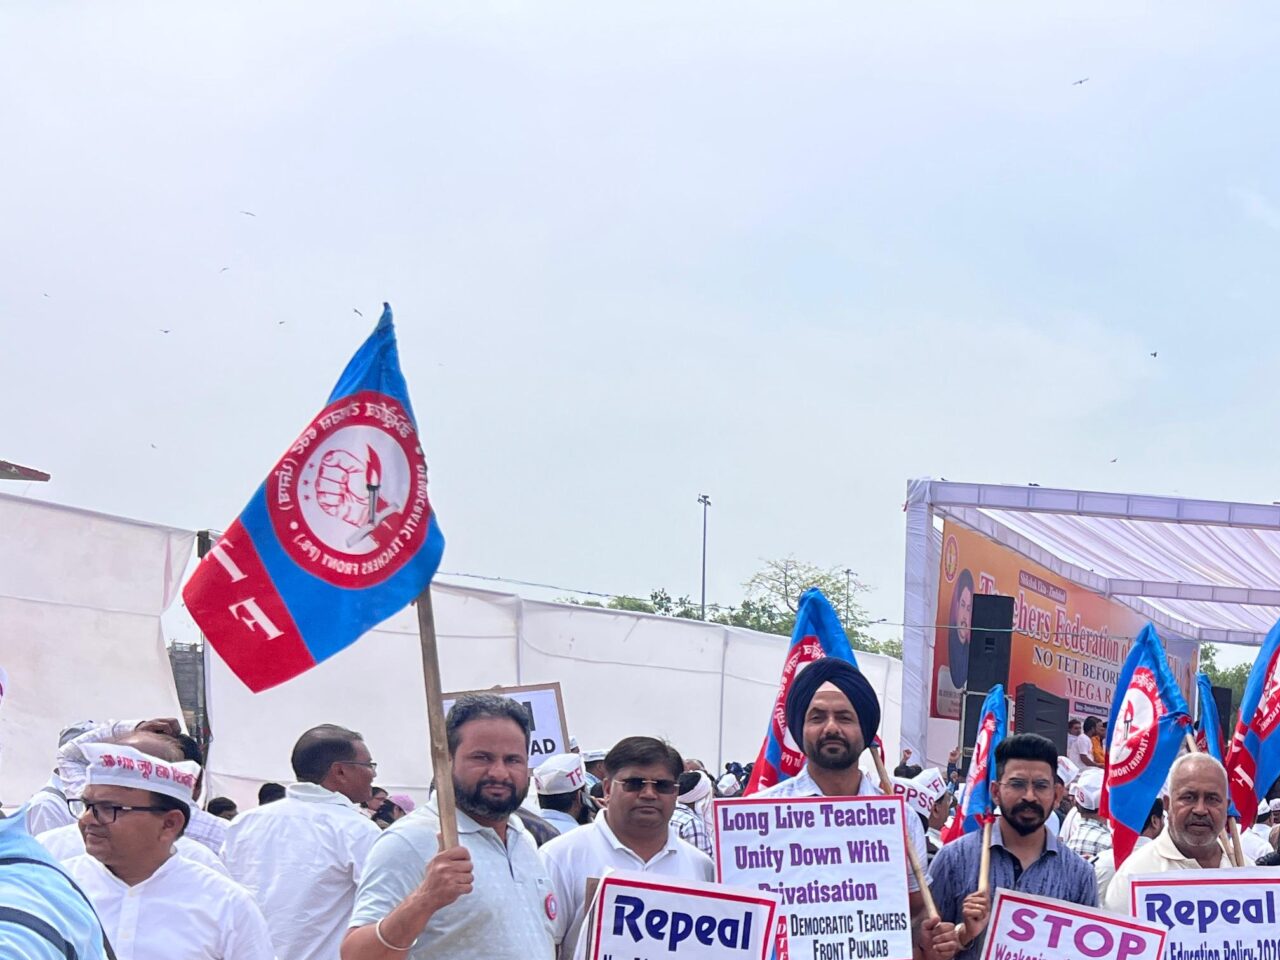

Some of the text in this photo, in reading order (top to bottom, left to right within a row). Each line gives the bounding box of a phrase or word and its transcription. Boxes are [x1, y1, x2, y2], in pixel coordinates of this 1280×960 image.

[980, 574, 1051, 641] Tchers
[1054, 608, 1119, 663] Federation
[1034, 646, 1053, 667] NO
[1056, 654, 1079, 675] TET
[722, 803, 896, 836] Long Live Teacher
[735, 839, 890, 873] Unity Down With
[613, 895, 753, 951] Repeal
[791, 910, 907, 936] DEMOCRATIC TEACHERS
[1145, 891, 1276, 933] Repeal
[849, 937, 889, 960] PUNJAB
